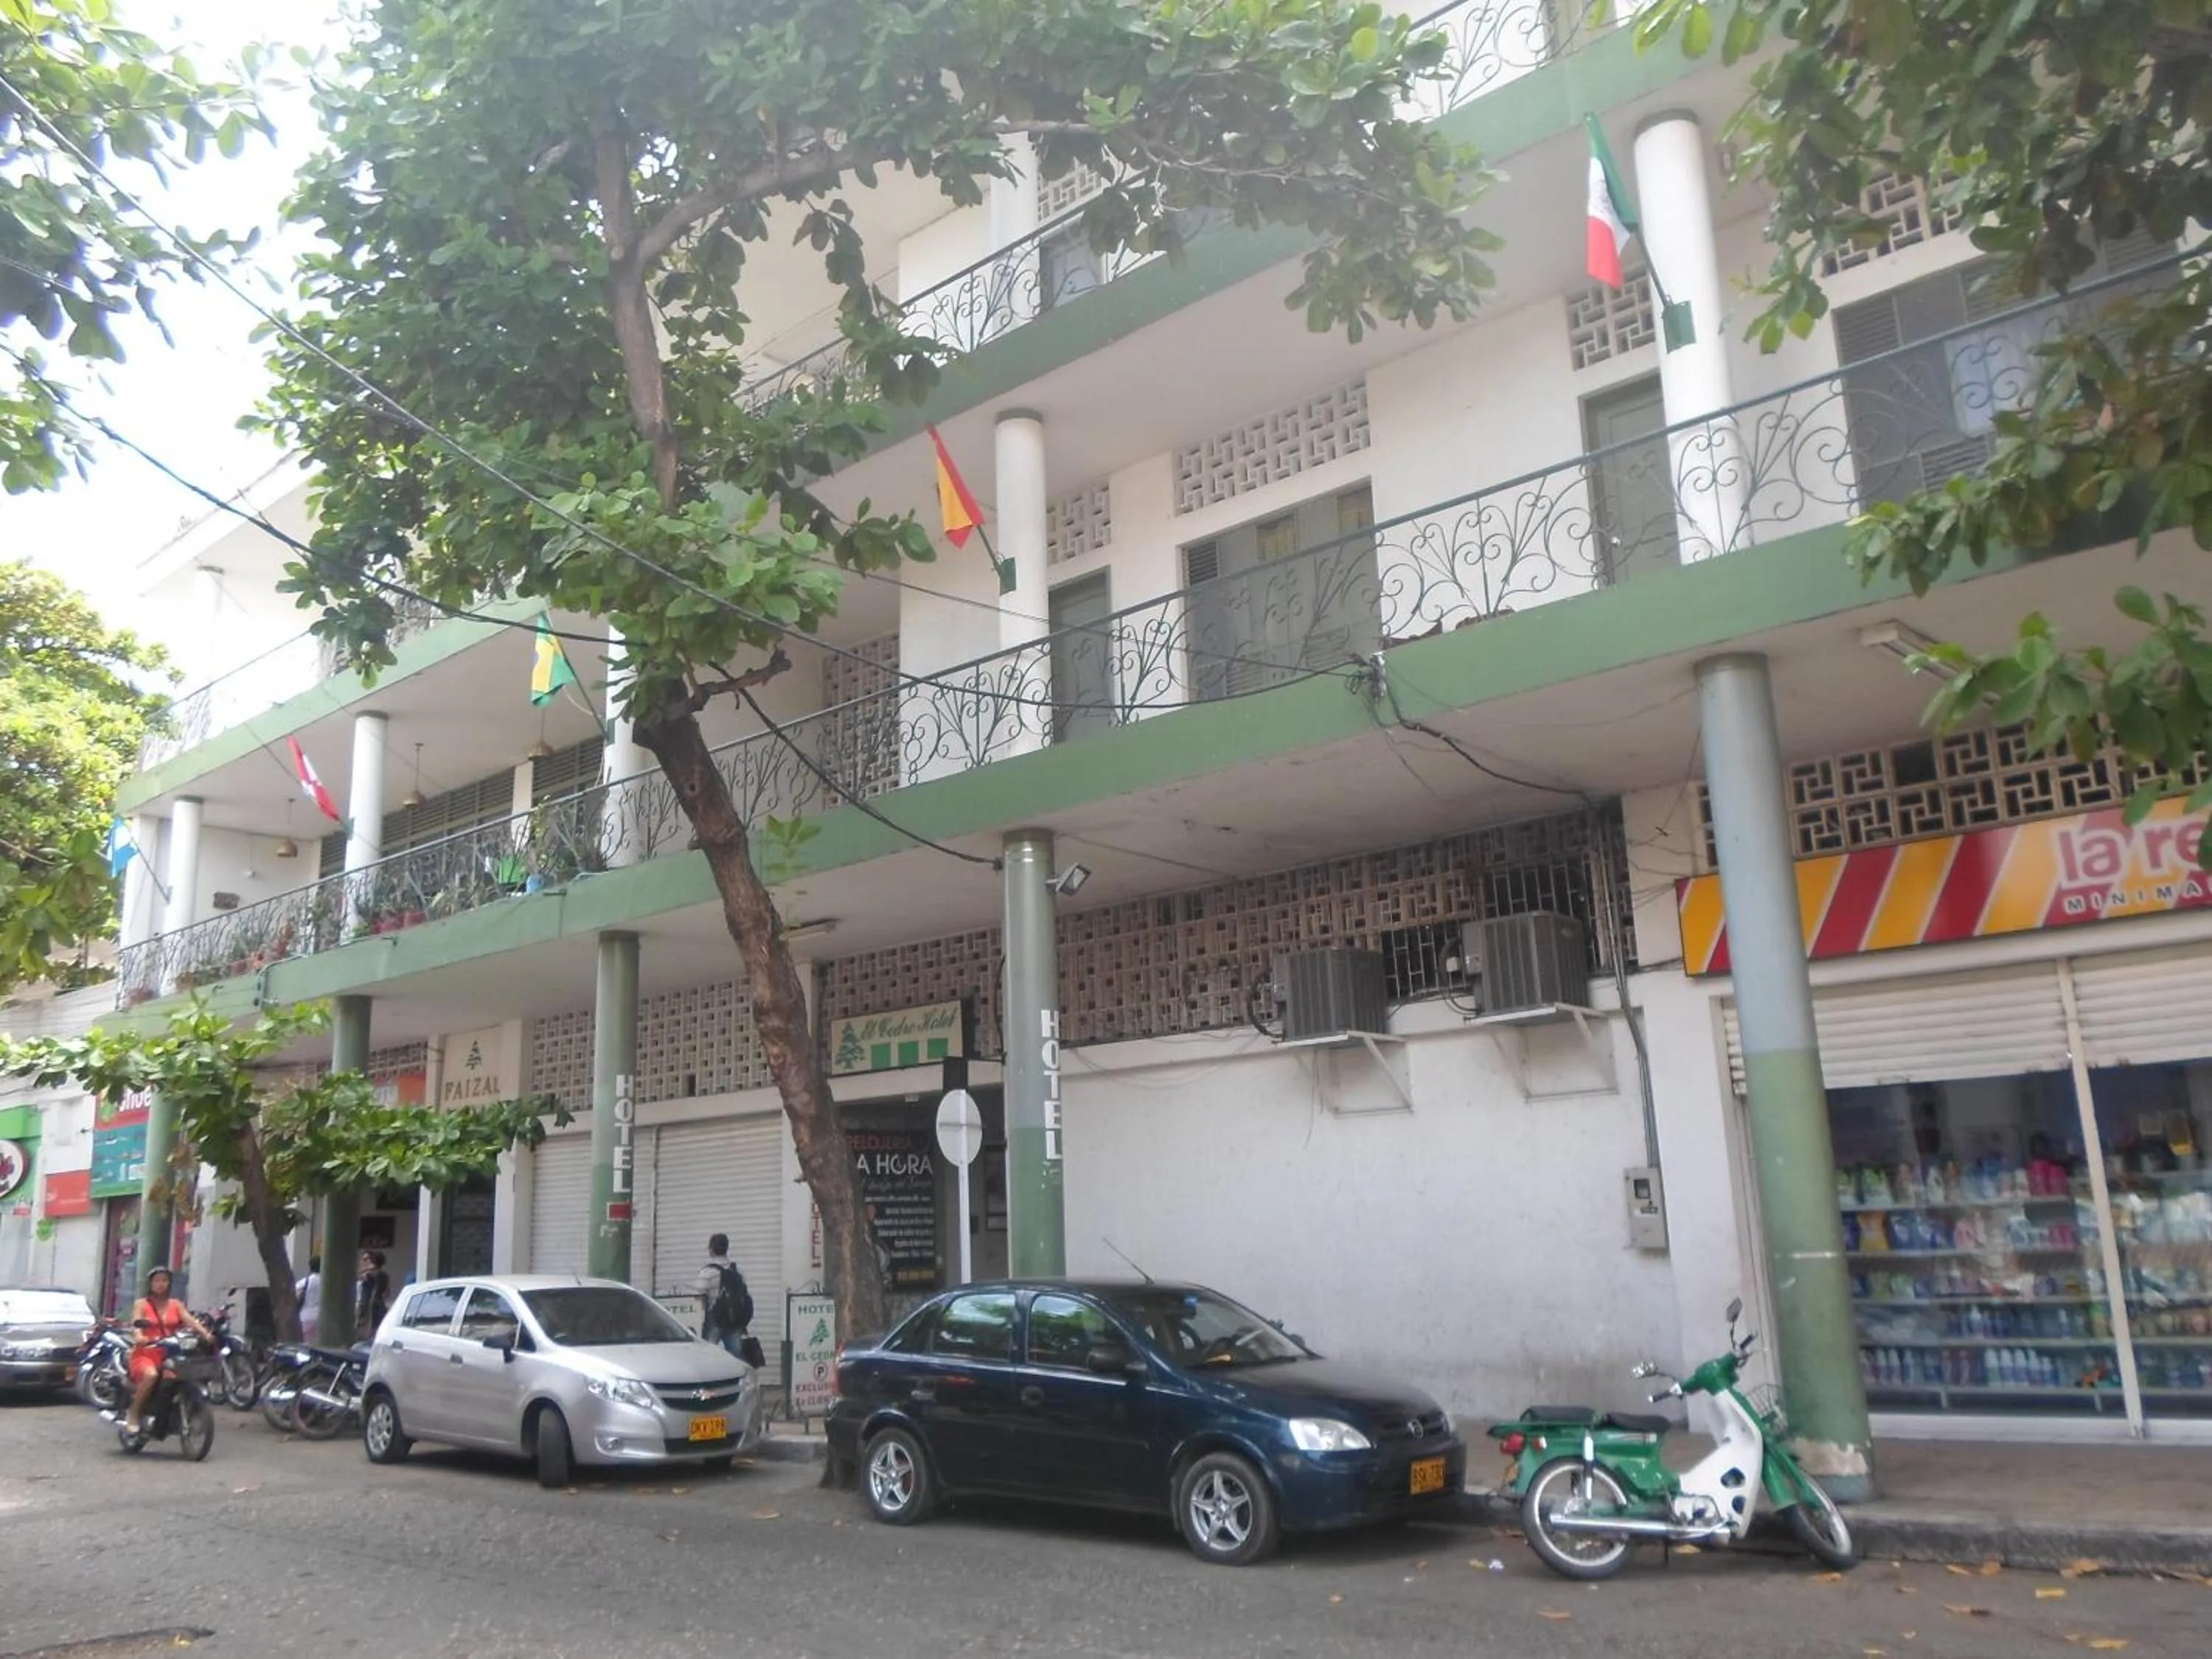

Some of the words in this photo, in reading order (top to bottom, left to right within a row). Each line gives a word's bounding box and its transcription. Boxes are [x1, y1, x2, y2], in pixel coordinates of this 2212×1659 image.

[2059, 830, 2121, 882] la
[2067, 882, 2202, 912] MINIMA
[445, 1074, 501, 1101] FAIZAL
[1040, 1009, 1062, 1160] HOTEL
[613, 1074, 634, 1193] HOTEL
[857, 1153, 871, 1175] A
[876, 1152, 933, 1175] HORA
[812, 1202, 822, 1259] OTEL
[798, 1304, 835, 1315] HOTE
[796, 1352, 807, 1362] EL
